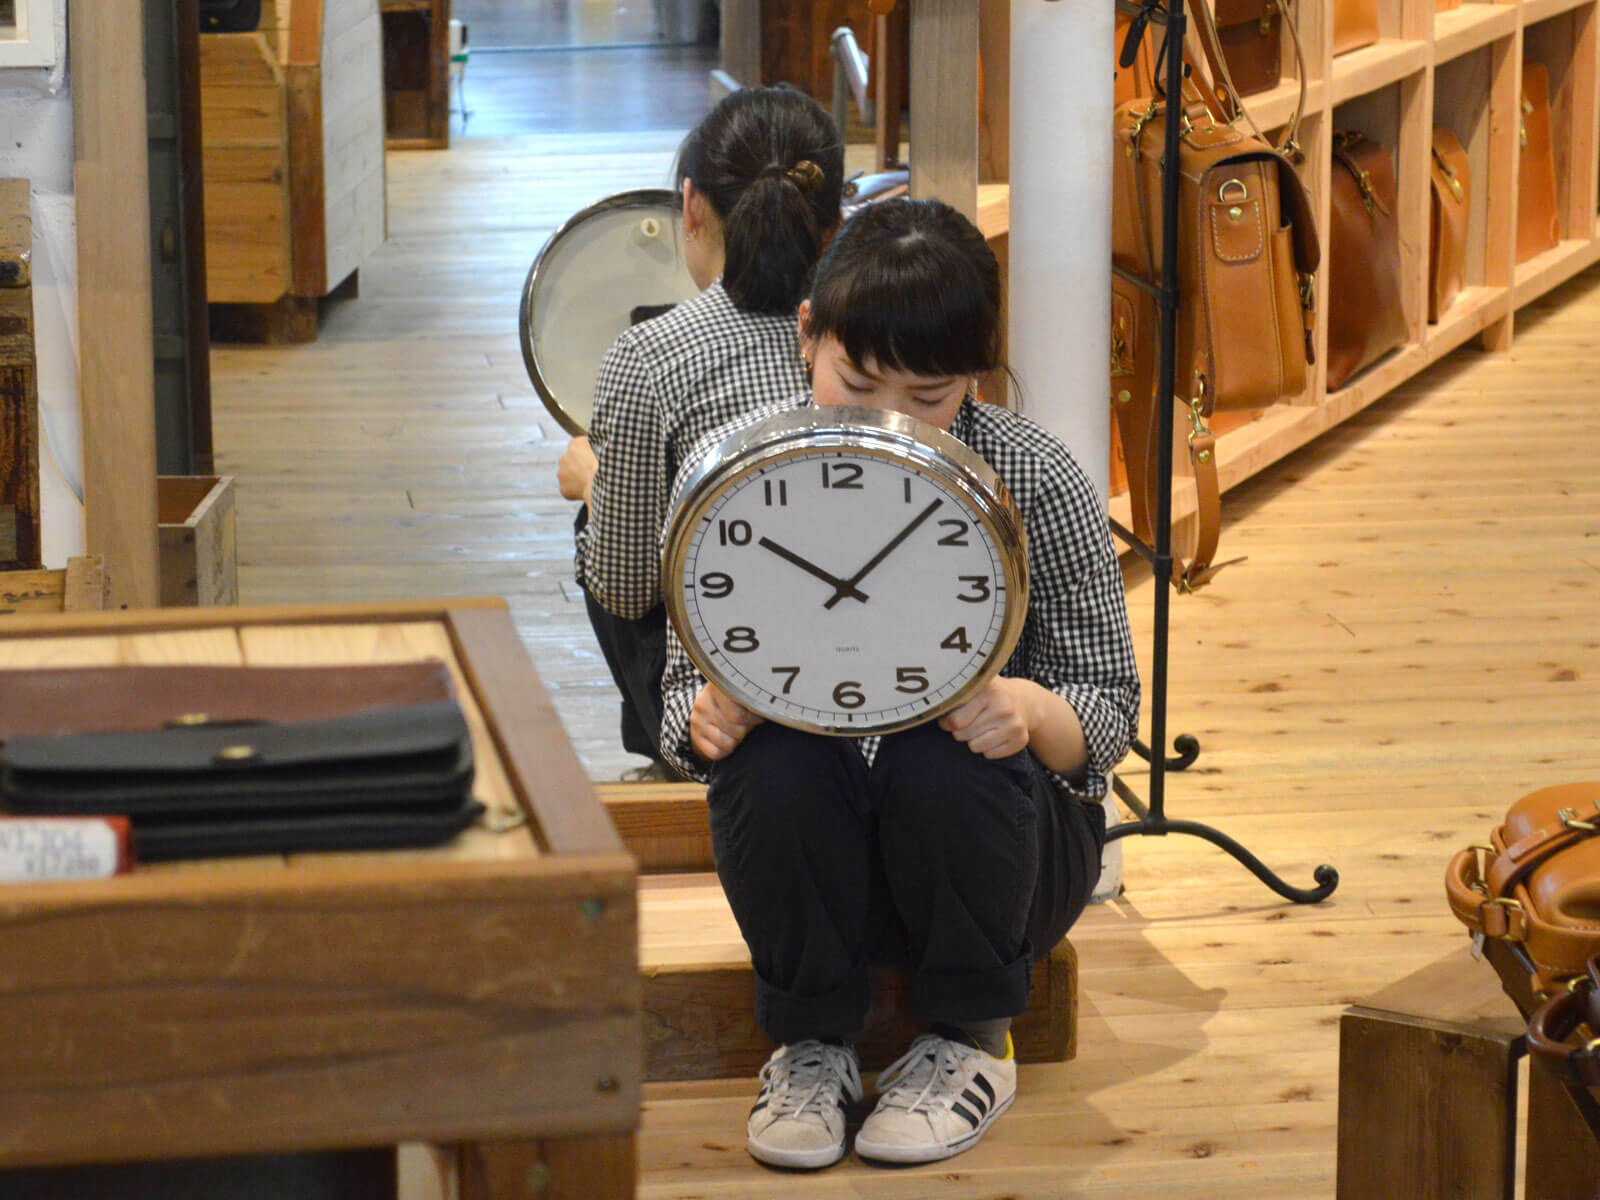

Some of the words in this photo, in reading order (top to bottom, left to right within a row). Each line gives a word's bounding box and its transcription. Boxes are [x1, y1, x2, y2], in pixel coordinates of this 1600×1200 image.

[821, 462, 864, 489] 12
[764, 479, 787, 506] 11
[903, 477, 912, 503] 1
[718, 519, 753, 547] 10
[937, 518, 969, 547] 2
[699, 571, 735, 599] 9
[956, 575, 991, 604] 3
[723, 626, 760, 654] 8
[940, 626, 973, 654] 4
[771, 666, 801, 695] 7
[895, 666, 930, 695] 5
[832, 681, 866, 710] 6
